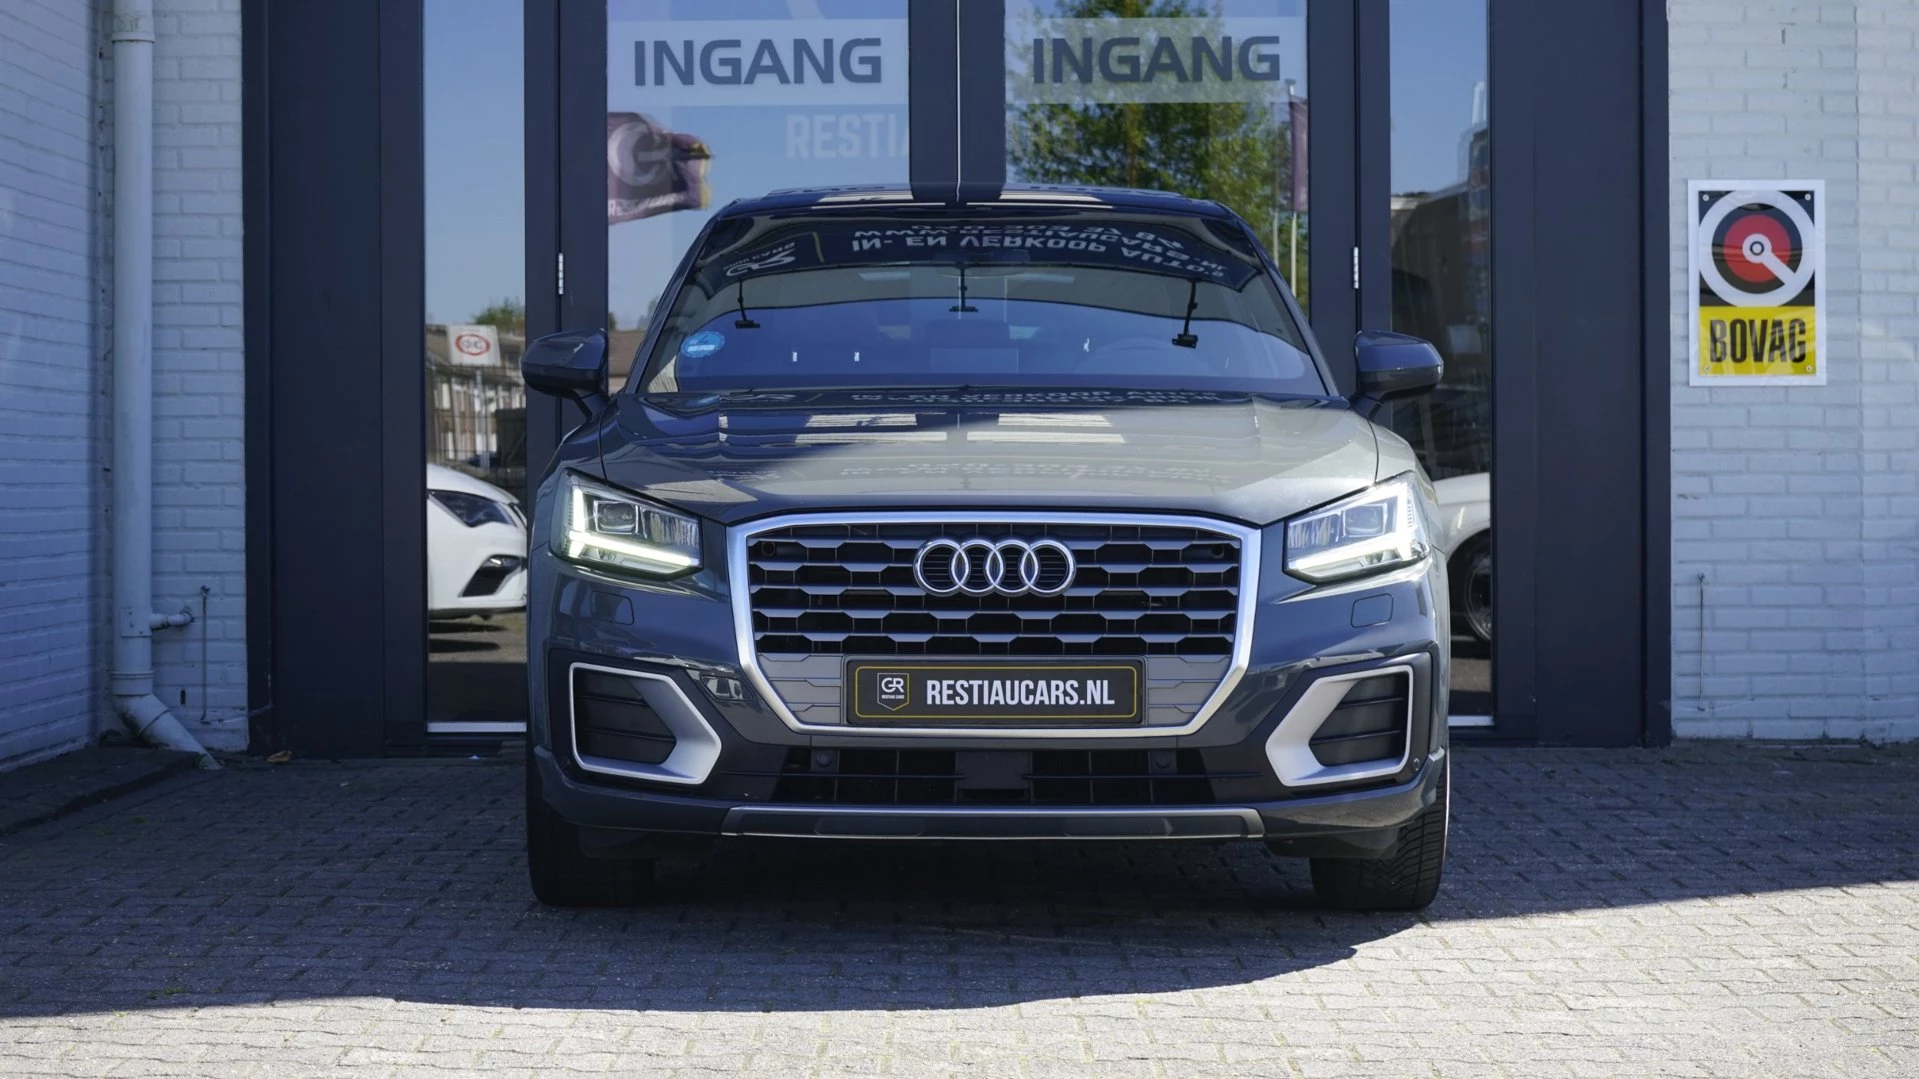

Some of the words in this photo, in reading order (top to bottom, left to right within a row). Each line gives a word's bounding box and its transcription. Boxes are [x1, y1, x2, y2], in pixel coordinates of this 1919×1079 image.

[634, 38, 882, 86] INGANG
[1033, 36, 1280, 83] INGANG
[786, 113, 909, 158] RESTI
[1709, 318, 1806, 363] BOVAG
[881, 677, 904, 693] GR
[926, 680, 1115, 705] RESTIAUCARS.NL
